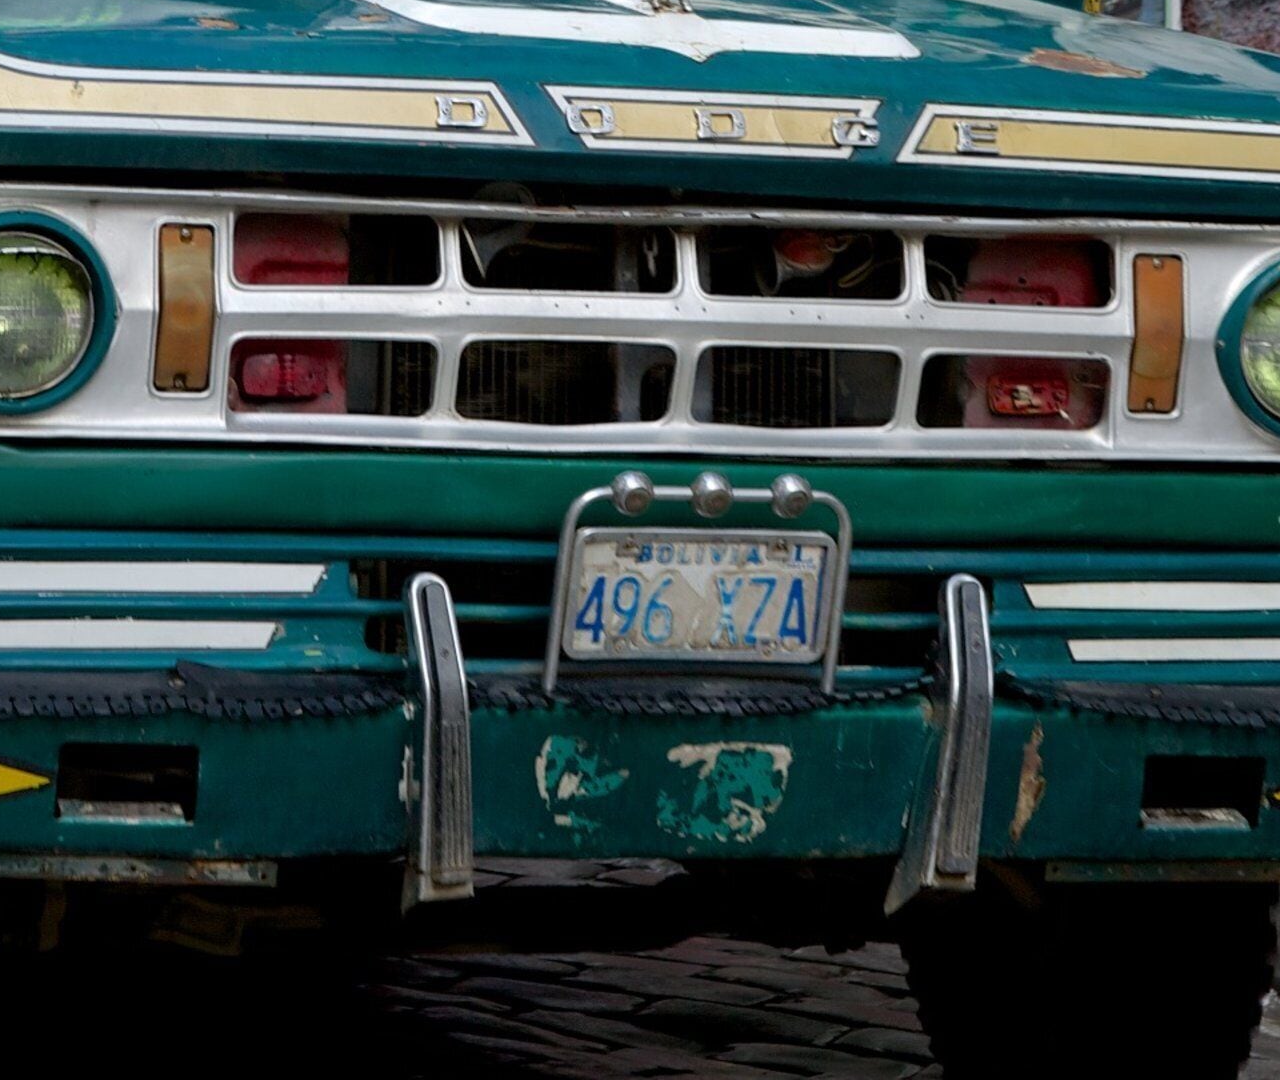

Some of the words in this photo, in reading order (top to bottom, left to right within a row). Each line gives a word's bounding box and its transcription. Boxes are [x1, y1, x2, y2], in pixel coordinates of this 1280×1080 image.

[435, 94, 1000, 156] DODGE
[575, 575, 676, 645] 496
[710, 575, 808, 647] XZA
